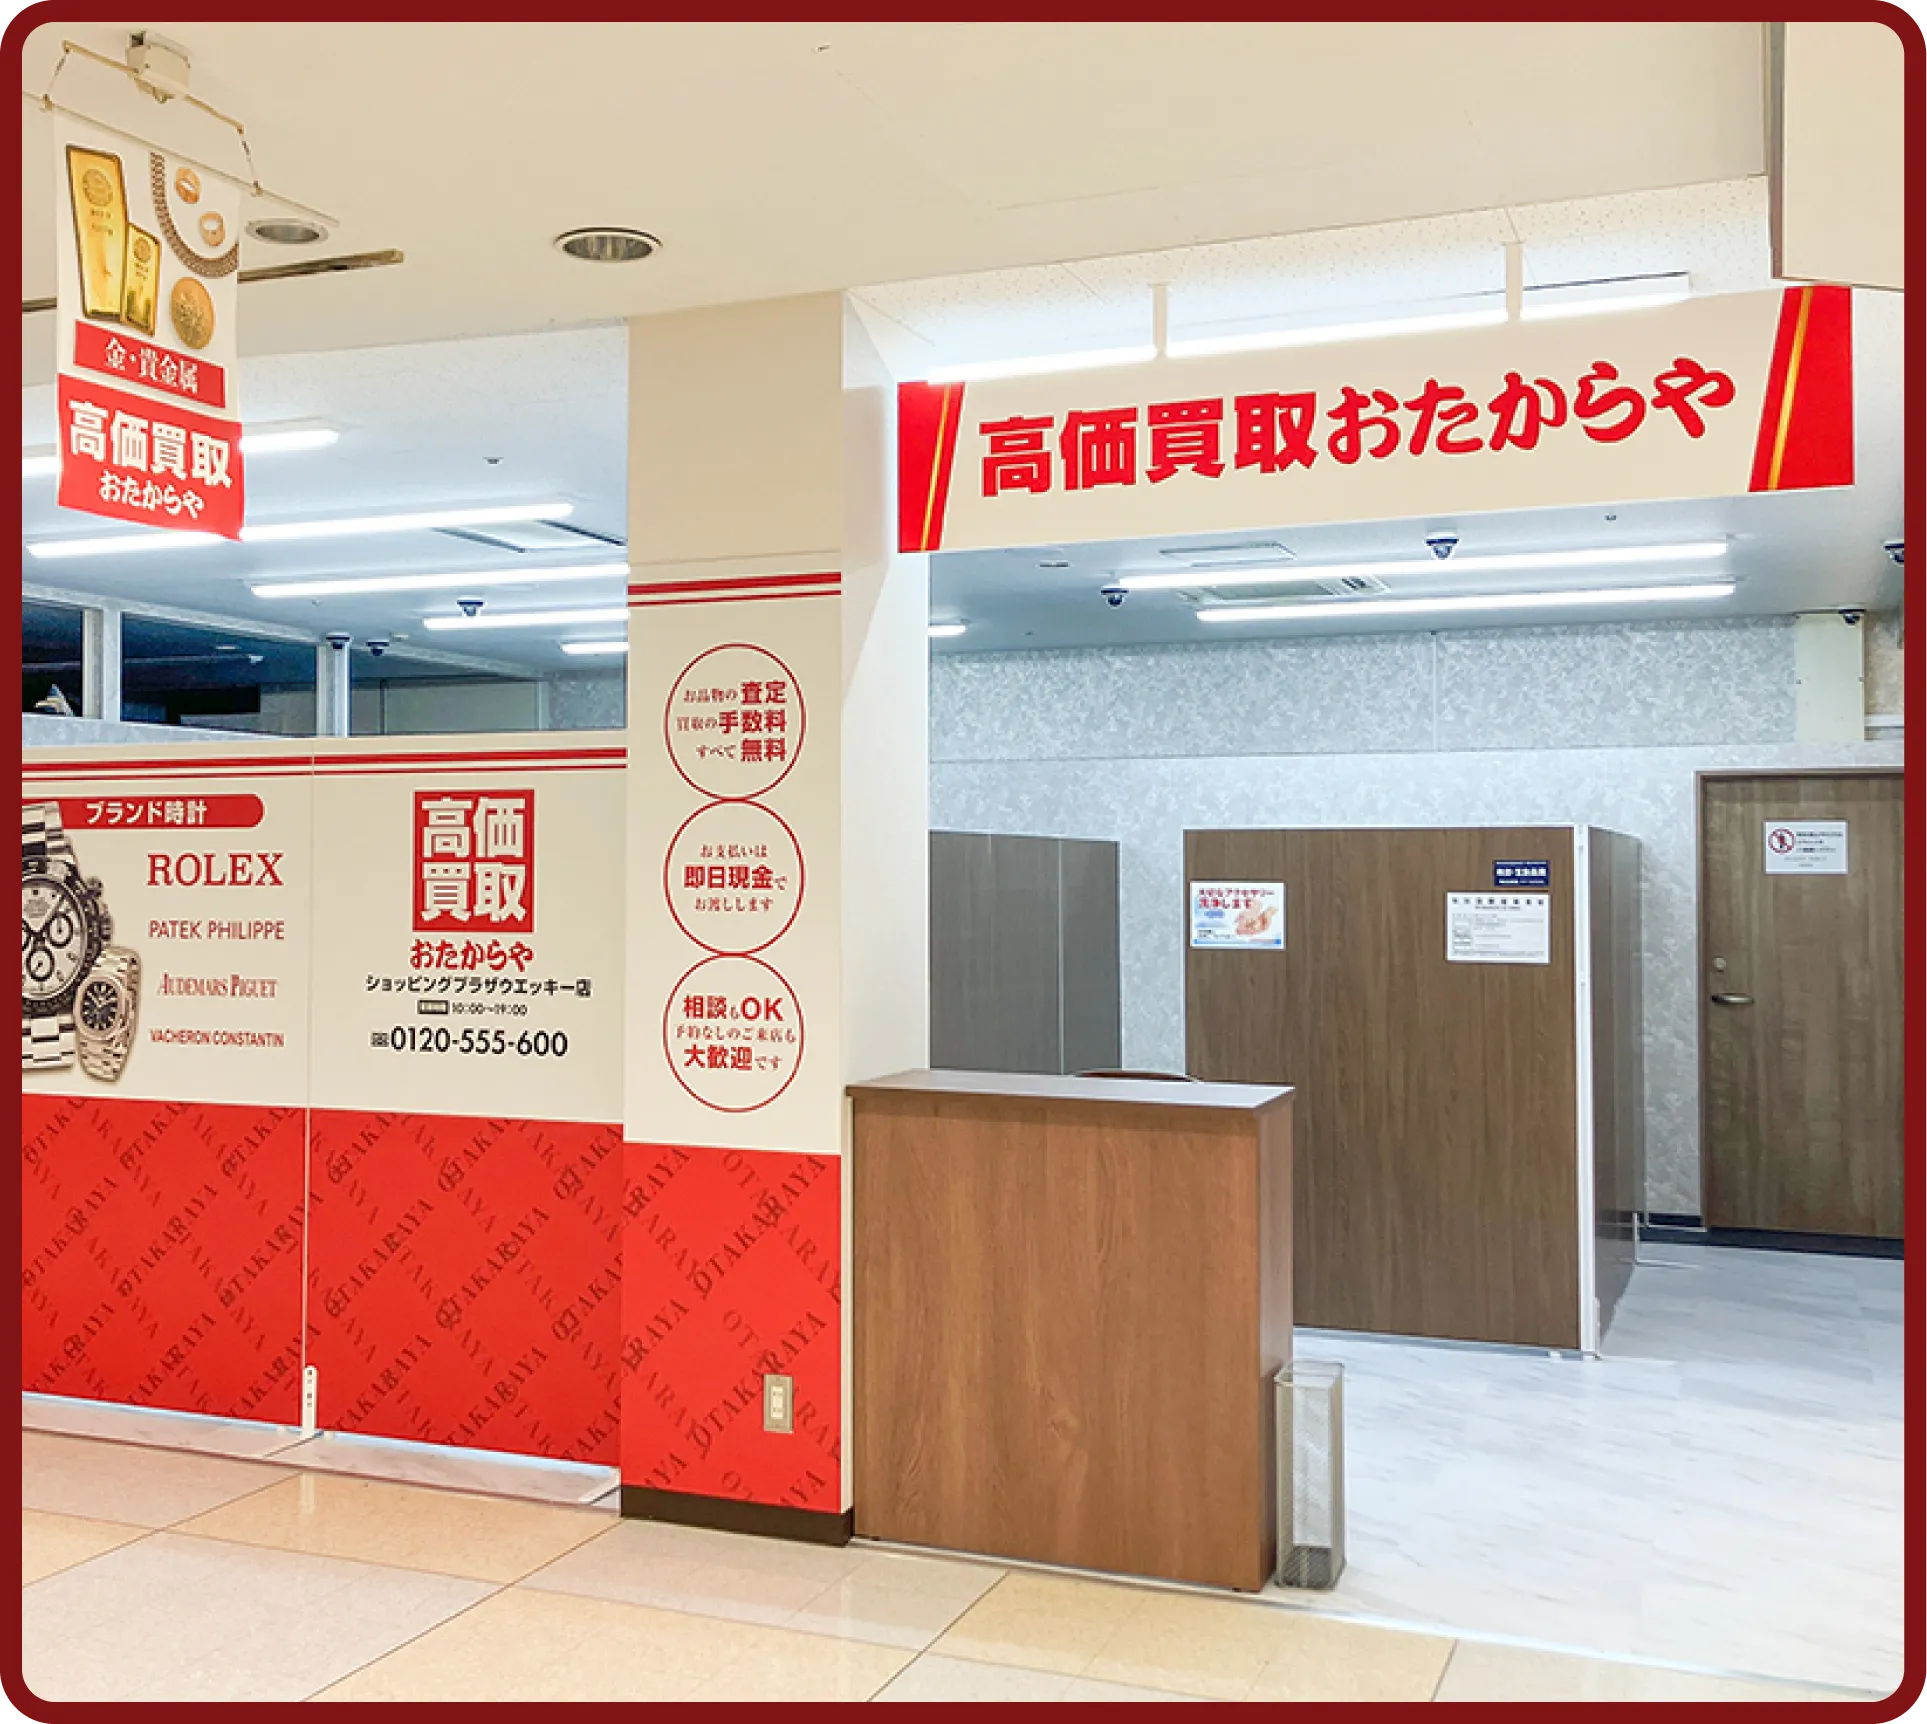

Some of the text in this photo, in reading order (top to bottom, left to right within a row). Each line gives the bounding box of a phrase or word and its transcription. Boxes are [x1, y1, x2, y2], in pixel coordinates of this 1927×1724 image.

[68, 400, 232, 488] 高価買取
[99, 470, 204, 519] おたからや
[86, 801, 208, 825] ブランド時計
[147, 853, 284, 886] ROLEX
[683, 864, 788, 891] 即日現金で
[148, 920, 285, 940] PATEK PHILIPPE
[410, 938, 534, 973] おたからや
[150, 1028, 285, 1049] VACHERON CONSTANTIN
[391, 1026, 568, 1057] 0120-555-600
